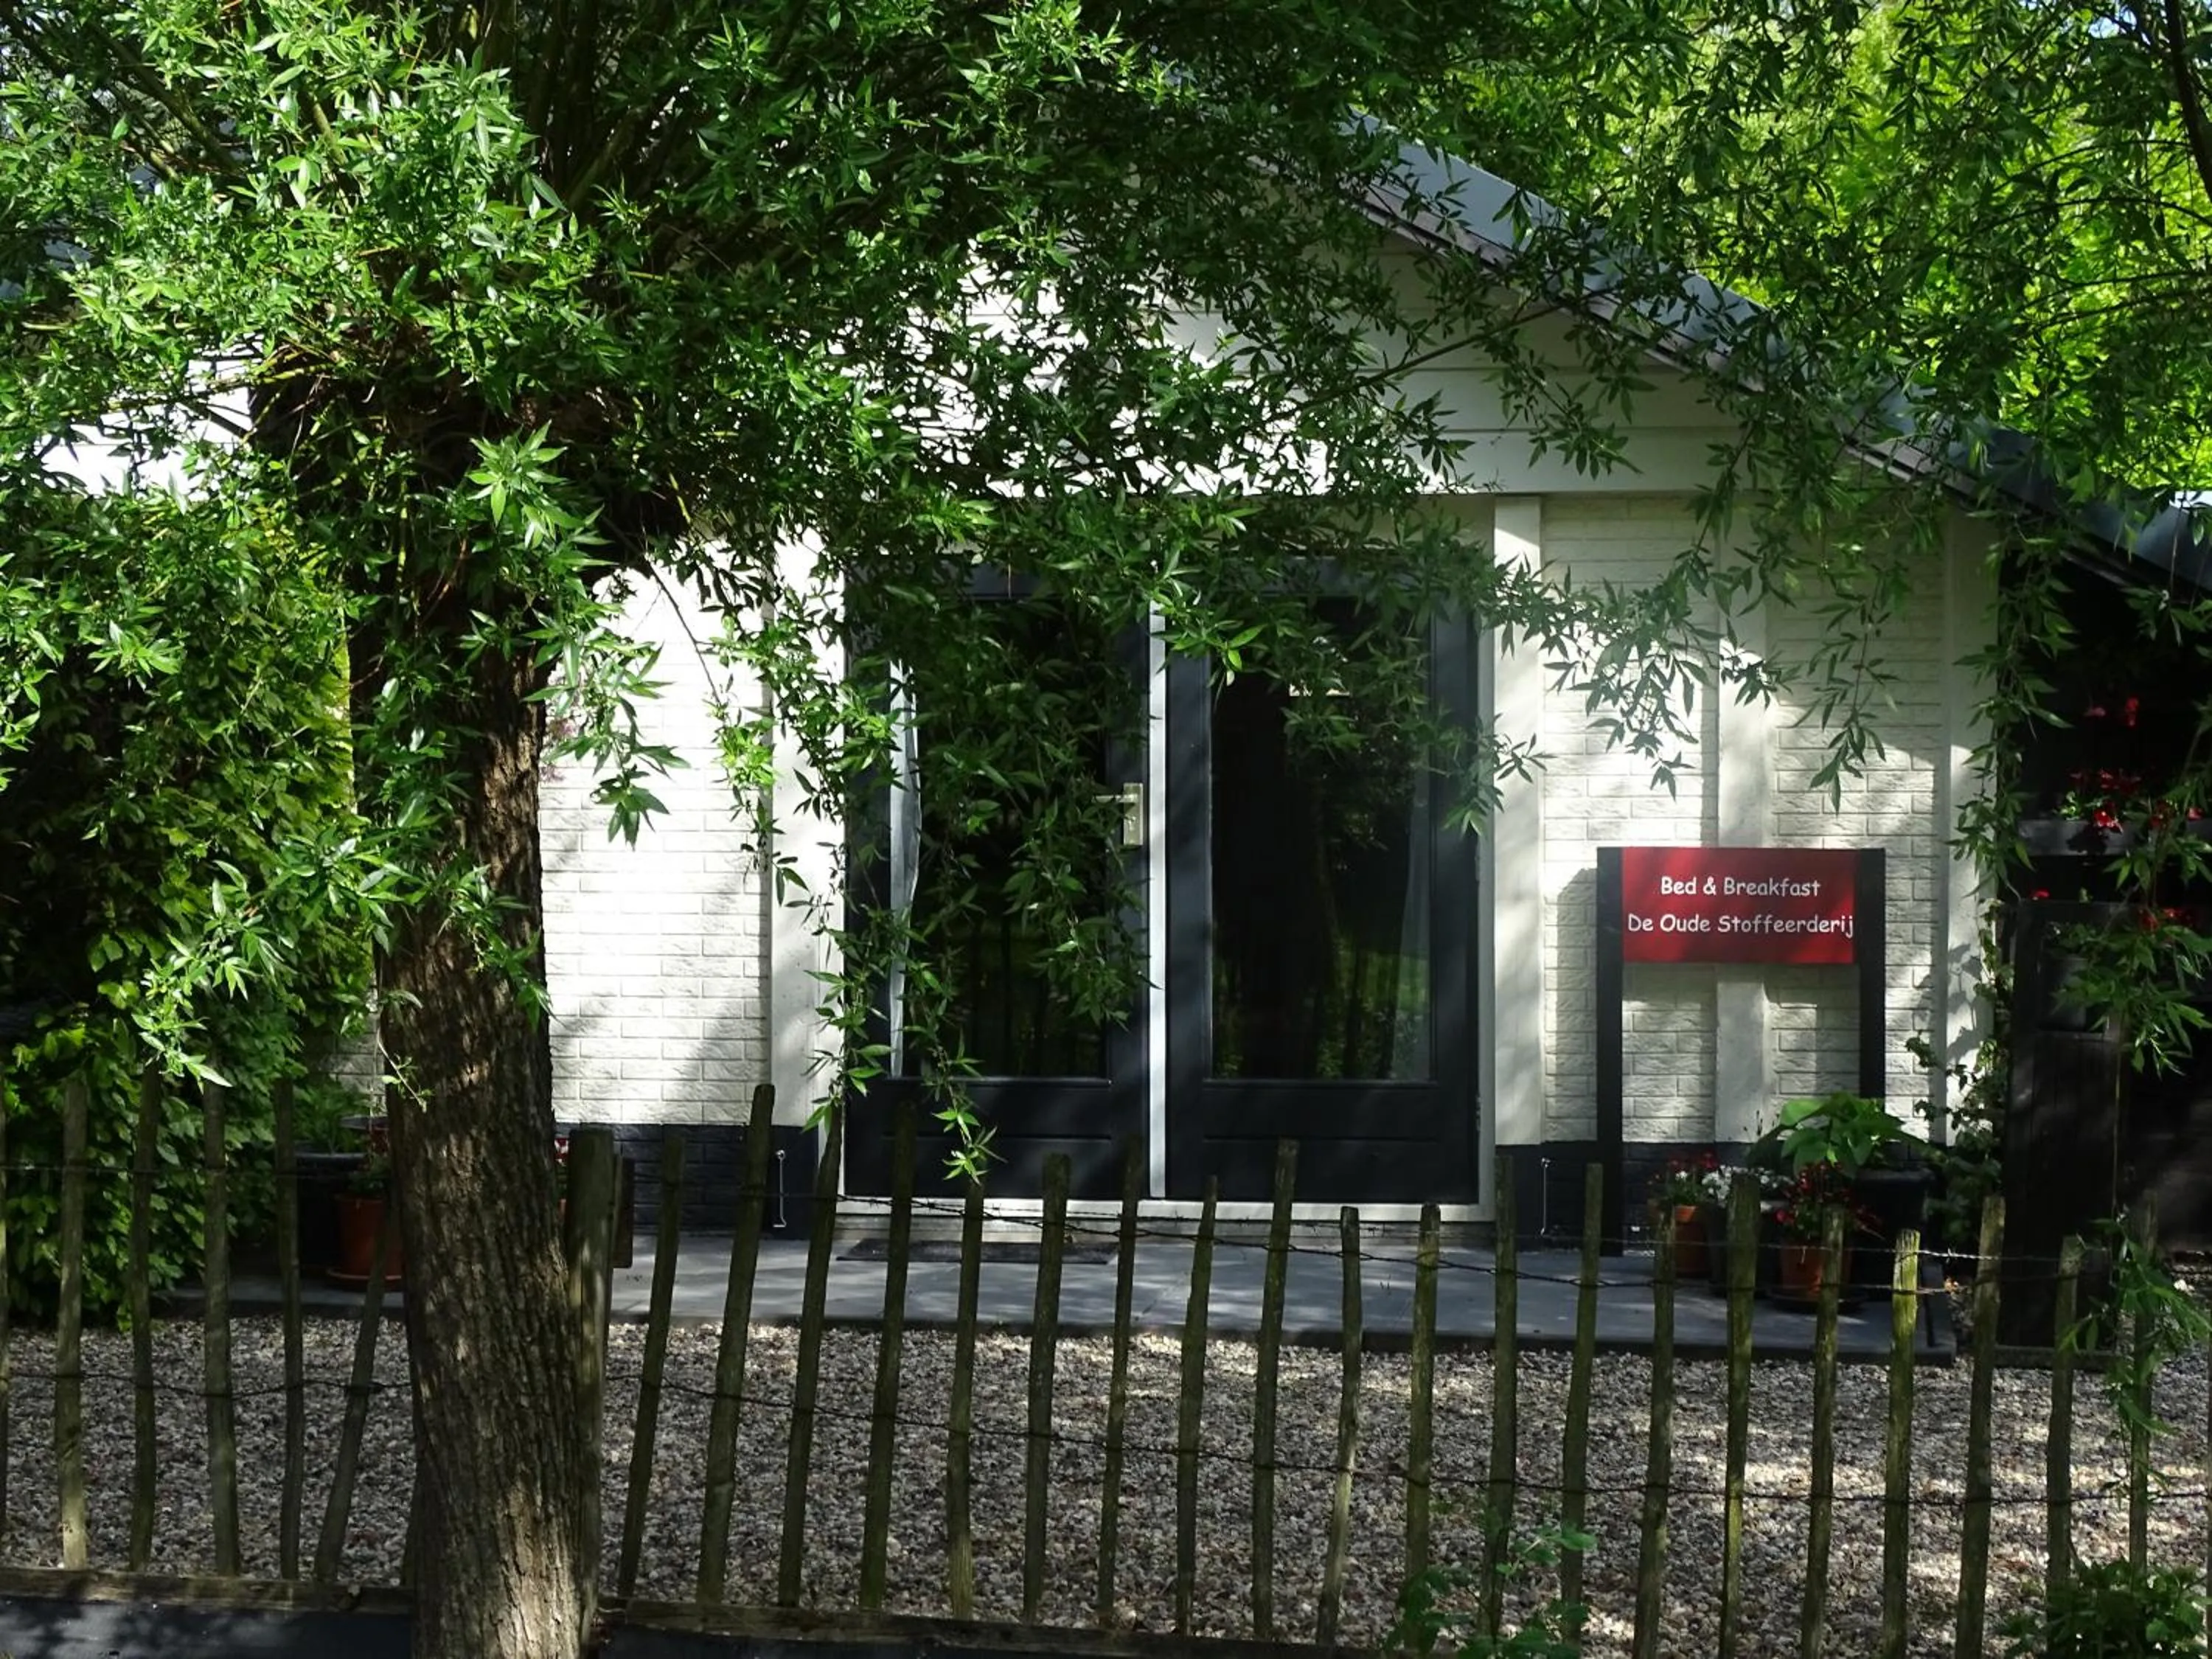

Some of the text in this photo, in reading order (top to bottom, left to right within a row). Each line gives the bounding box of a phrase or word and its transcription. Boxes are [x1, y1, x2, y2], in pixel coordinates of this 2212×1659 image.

[1660, 875, 1821, 897] Bed & Breakfast
[1628, 913, 1854, 939] De Oude Stoffeerderij
